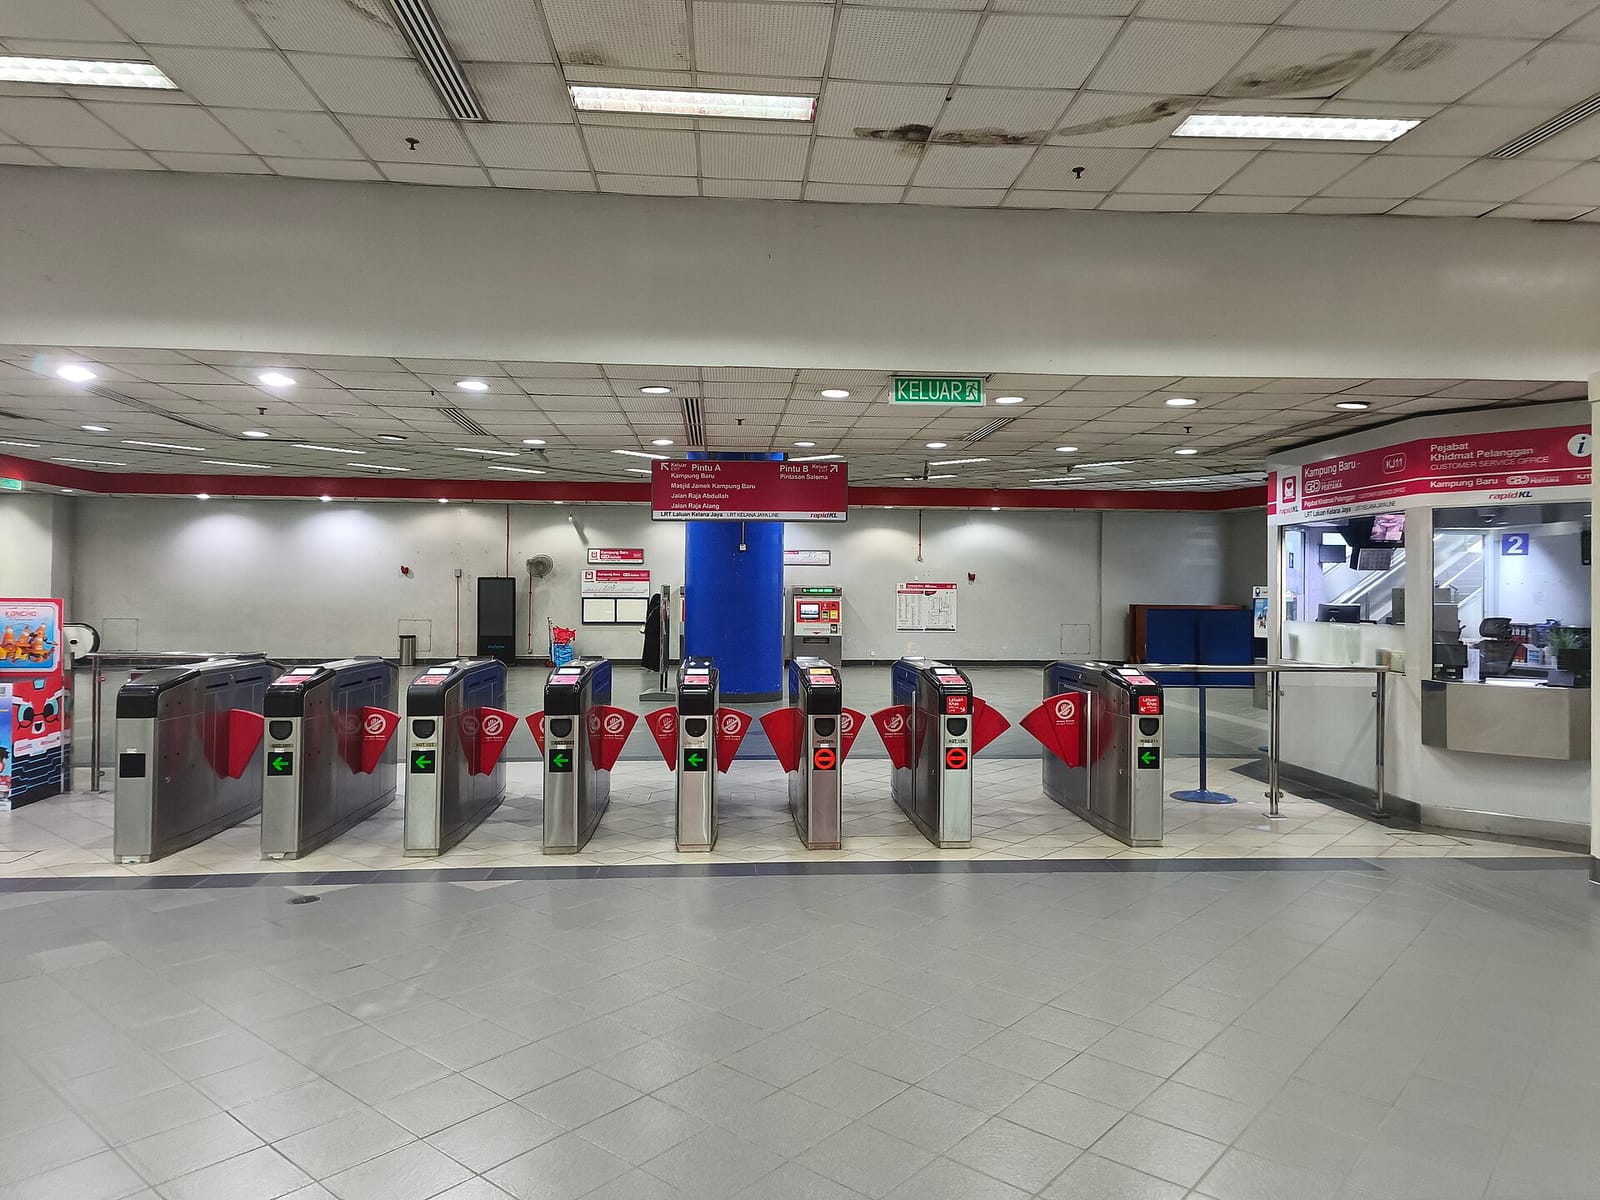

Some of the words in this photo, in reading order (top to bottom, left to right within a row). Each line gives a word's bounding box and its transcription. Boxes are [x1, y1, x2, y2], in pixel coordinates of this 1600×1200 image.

[898, 381, 962, 400] KELUAR
[1430, 442, 1469, 452] Pejabat
[1430, 452, 1474, 462] Khidmat
[1476, 448, 1534, 459] Pelanggan
[691, 464, 713, 472] Pintu
[714, 464, 722, 472] A
[779, 465, 801, 473] Pintu
[1304, 465, 1337, 478] Kampung
[1338, 460, 1356, 472] Baru
[1385, 458, 1403, 469] KJ11
[1430, 462, 1476, 471] CUSTOMER
[1479, 458, 1515, 467] SERVICE
[1517, 456, 1550, 465] OFFICE
[1430, 479, 1473, 489] Kampung
[1476, 478, 1498, 486] Baru
[1488, 491, 1533, 500] rapidKL
[1507, 535, 1523, 554] 2
